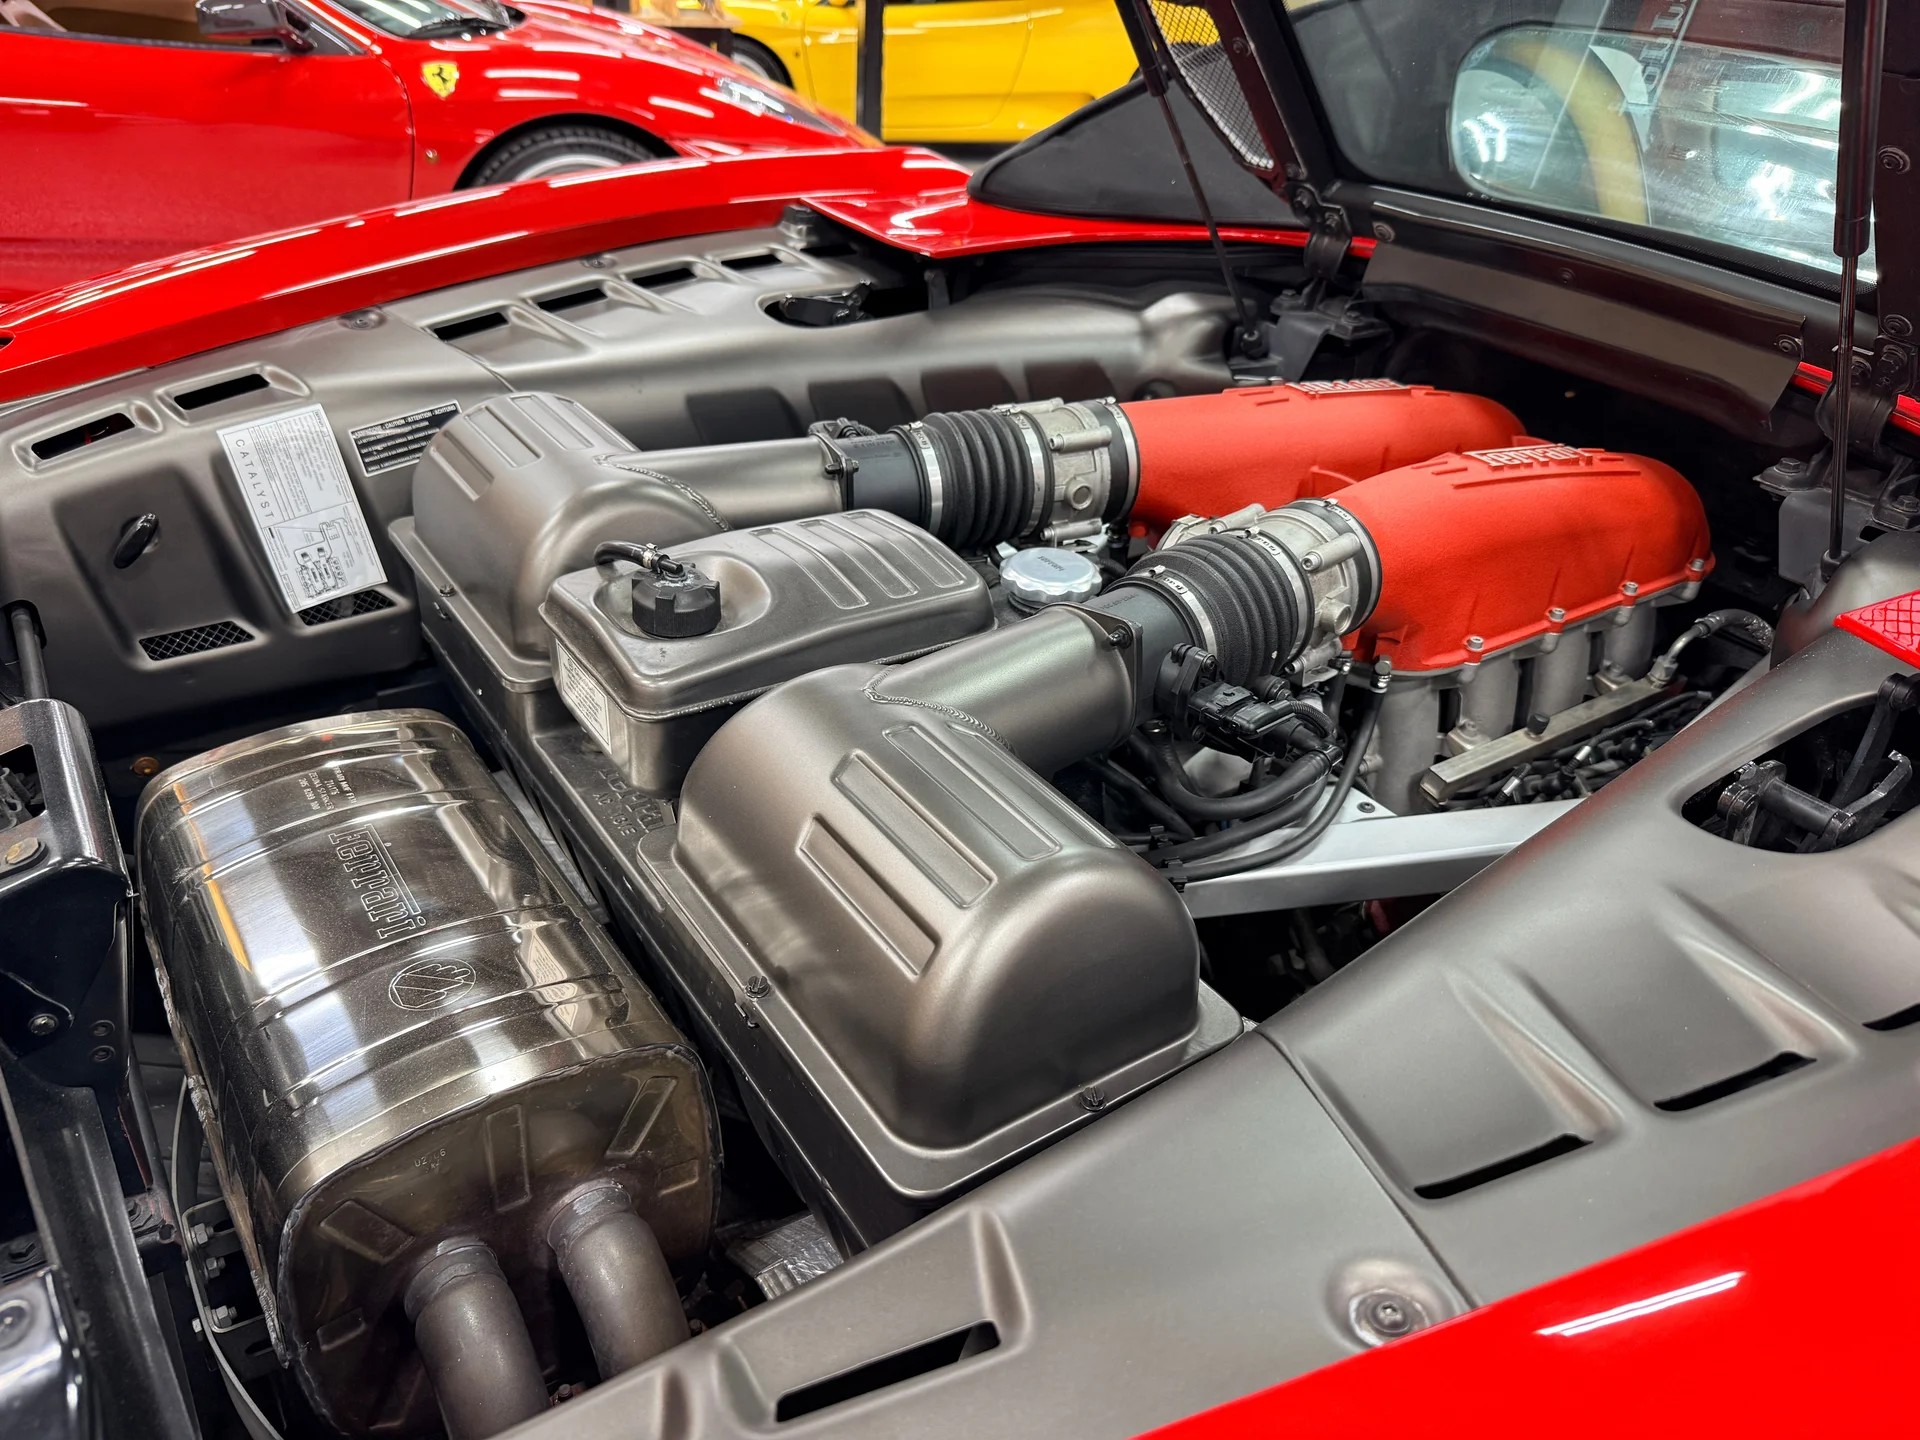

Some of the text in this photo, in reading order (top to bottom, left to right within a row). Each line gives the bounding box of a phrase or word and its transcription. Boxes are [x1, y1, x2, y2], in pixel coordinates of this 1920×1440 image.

[235, 439, 275, 518] CATALYST
[1462, 443, 1593, 468] Ferrari
[328, 823, 427, 940] Ferrari
